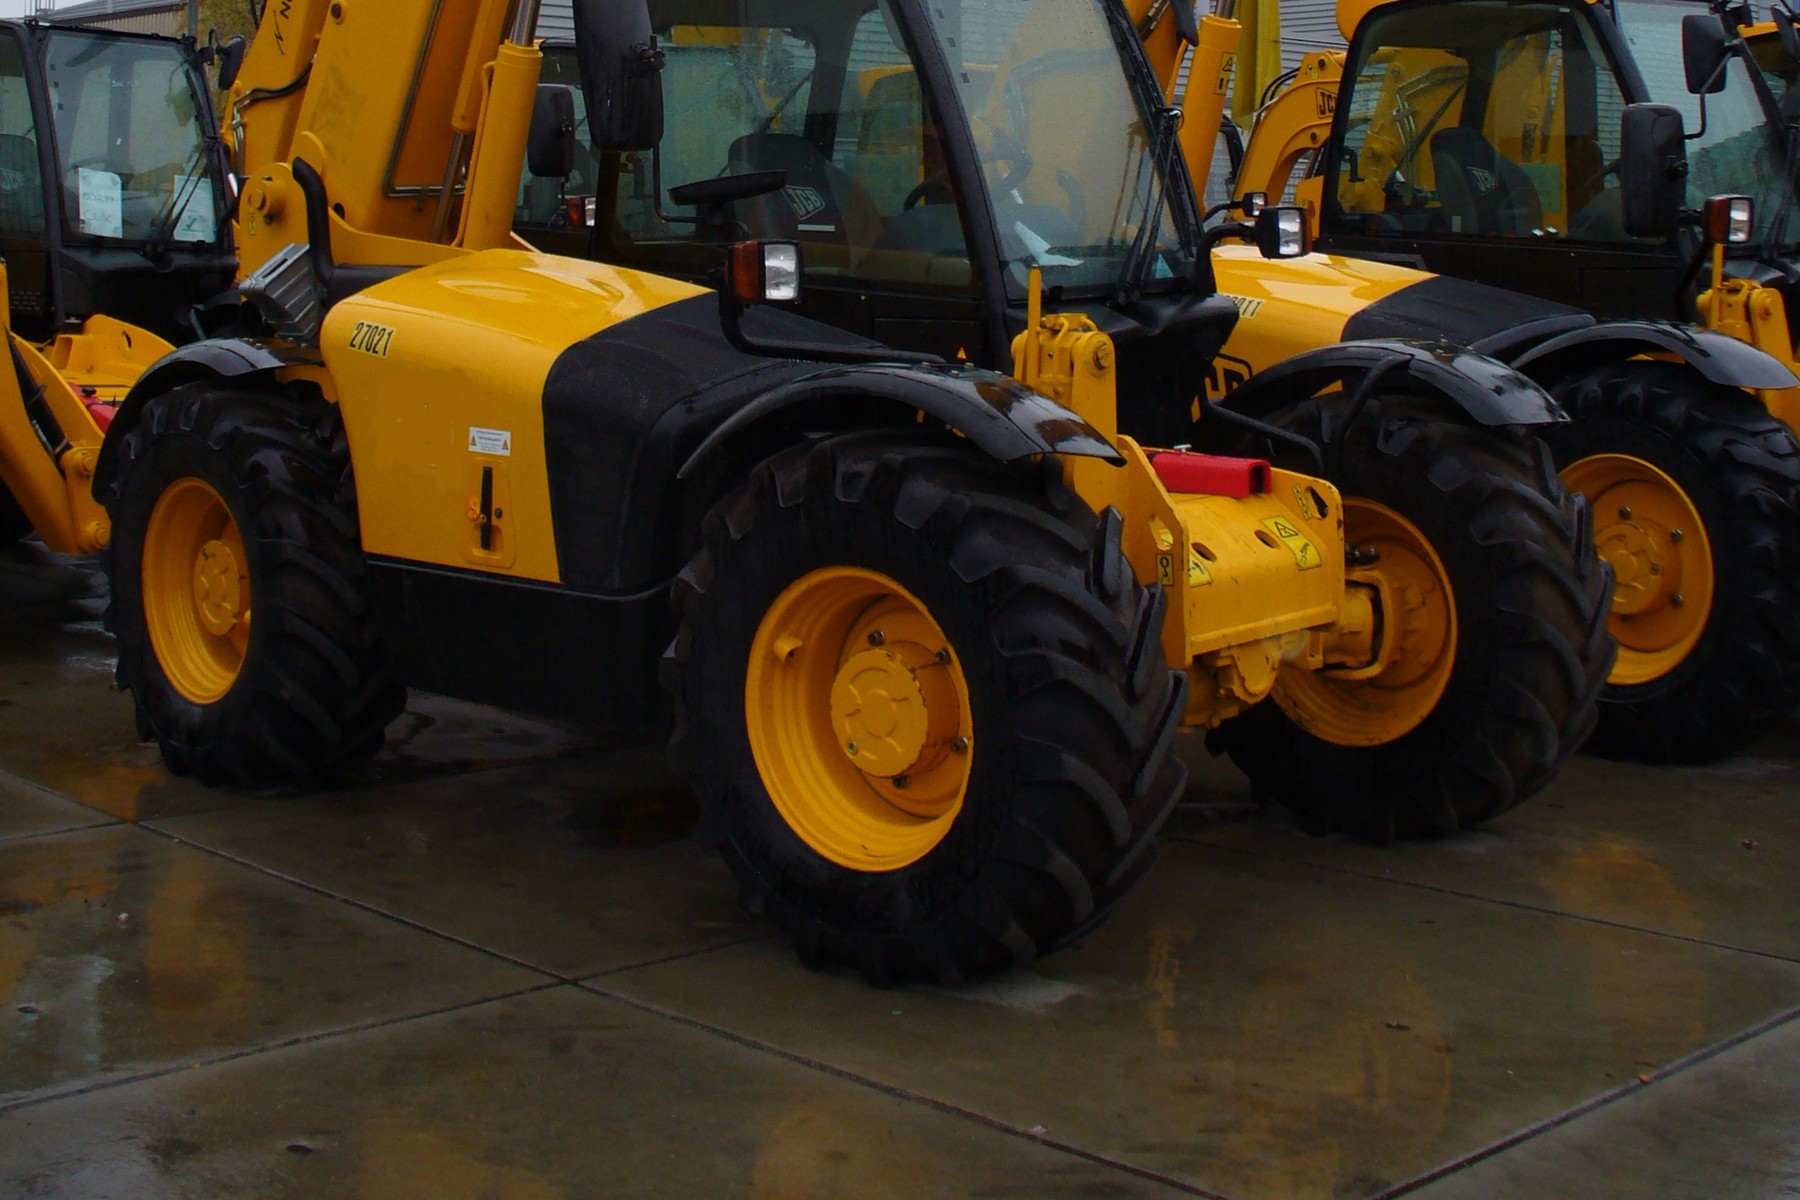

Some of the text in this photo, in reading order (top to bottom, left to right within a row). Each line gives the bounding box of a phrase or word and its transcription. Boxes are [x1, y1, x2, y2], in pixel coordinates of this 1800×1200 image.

[1319, 91, 1336, 116] JC
[786, 188, 821, 216] JCB
[349, 321, 394, 356] 27021
